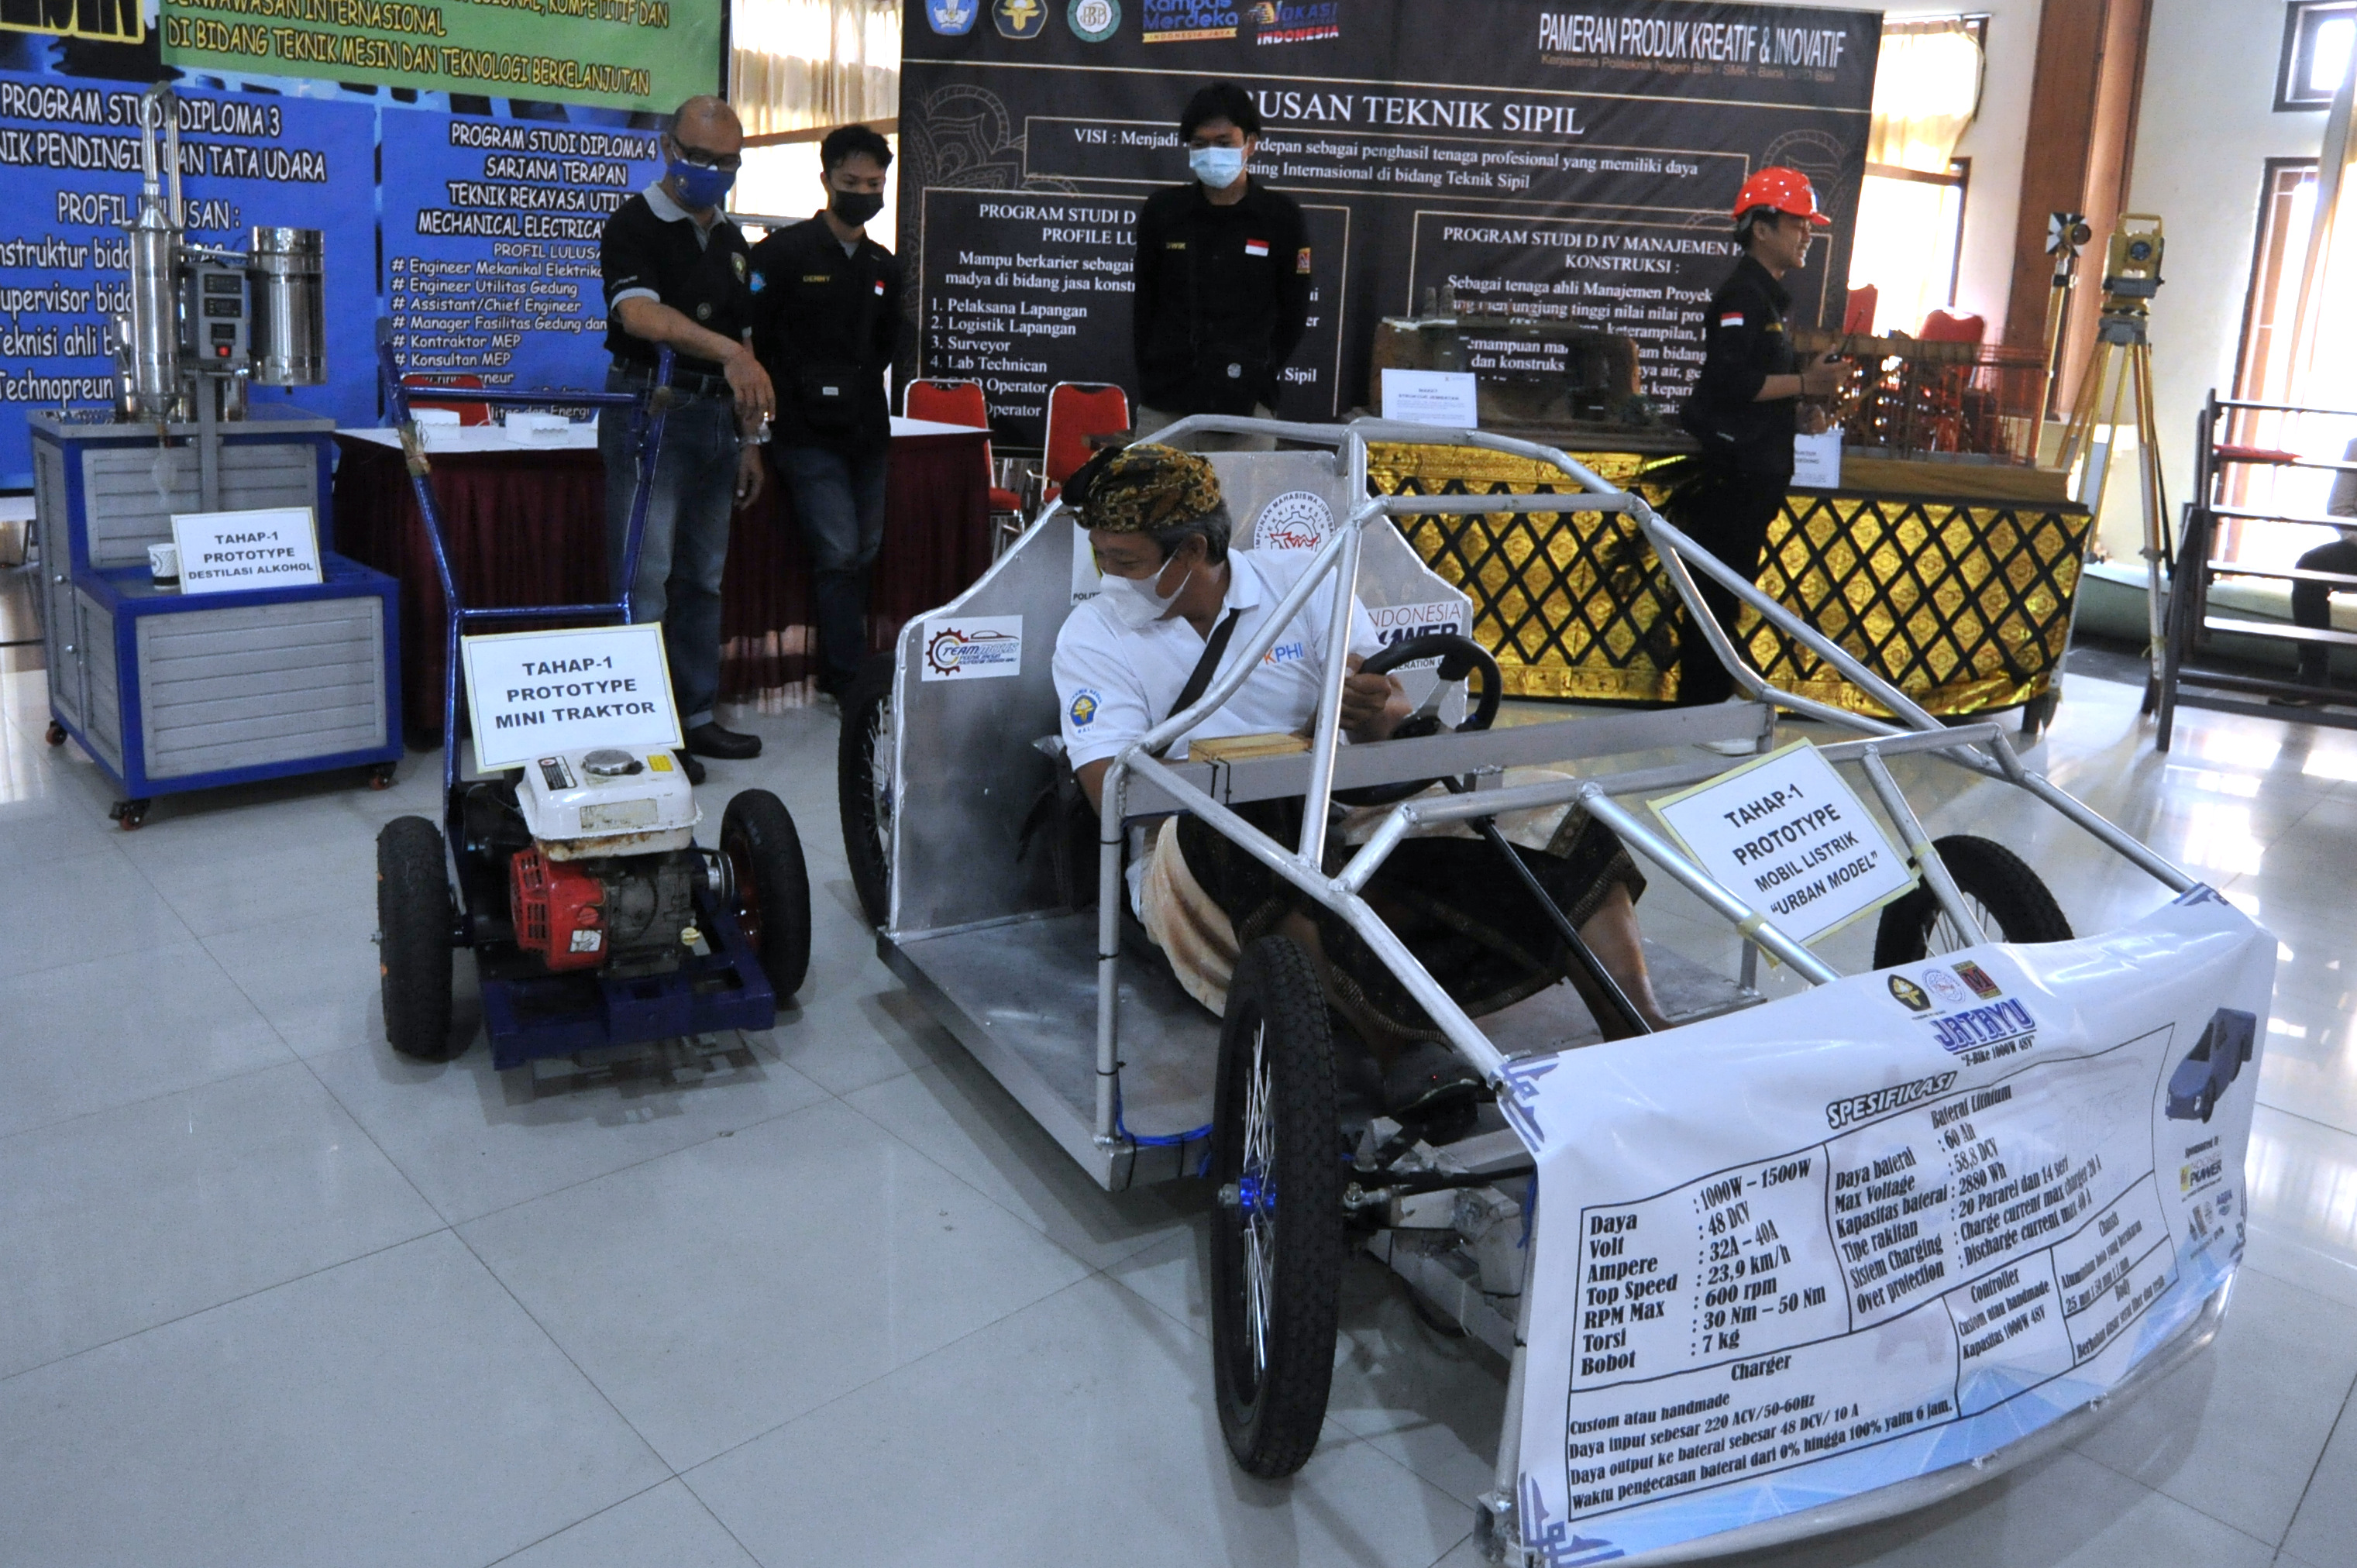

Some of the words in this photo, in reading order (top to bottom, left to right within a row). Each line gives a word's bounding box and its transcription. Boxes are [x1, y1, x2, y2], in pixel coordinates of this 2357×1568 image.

[305, 0, 446, 36] INTERNASIONAL
[638, 2, 668, 27] DAN
[1143, 10, 1237, 30] Merdeka
[1257, 25, 1338, 45] INDONESIA
[1539, 13, 1616, 54] PAMERAN
[1619, 19, 1688, 58] PRODUK
[1691, 22, 1757, 62] KREATIF
[1774, 28, 1846, 67] INOVATIF
[167, 19, 191, 46] DI
[196, 19, 268, 55] BIDANG
[273, 29, 337, 63] TEKNIK
[340, 36, 397, 67] MESIN
[402, 43, 437, 74] DAN
[441, 46, 528, 81] TEKNOLOGI
[532, 58, 649, 95] BERKELANJUTAN
[2, 82, 102, 123] PROGRAM
[179, 100, 263, 135] DIPLOMA
[270, 108, 281, 136] 3
[1247, 91, 1354, 121] USAN
[1363, 95, 1492, 130] TEKNIK
[1502, 103, 1585, 135] SIPIL
[452, 122, 524, 150] PROGRAM
[529, 129, 576, 153] STUDI
[580, 134, 642, 158] DIPLOMA
[1074, 128, 1106, 144] VISI
[1121, 130, 1178, 150] Menjadi
[1306, 140, 1357, 159] sebagai
[1362, 144, 1428, 161] penghasil
[1482, 149, 1558, 169] profesional
[1601, 156, 1661, 174] memiliki
[209, 146, 259, 178] TATA
[264, 150, 325, 181] UDARA
[486, 156, 557, 181] SARJANA
[563, 160, 626, 185] TERAPAN
[1283, 162, 1372, 179] Internasional
[1447, 170, 1493, 187] Teknik
[1497, 173, 1529, 190] Sipil
[57, 191, 131, 225] PROFIL
[449, 182, 507, 206] TEKNIK
[510, 186, 584, 211] REKAYASA
[418, 211, 520, 237] MECHANICAL
[525, 215, 605, 239] ELECTRICA
[979, 204, 1063, 221] PROGRAM
[1068, 208, 1118, 224] STUDI
[1042, 227, 1111, 244] PROFILE
[1443, 226, 1526, 245] PROGRAM
[1531, 231, 1581, 248] STUDI
[1623, 236, 1726, 256] MANAJEMEN
[409, 258, 470, 277] Engineer
[476, 261, 541, 277] Mekanikal
[959, 251, 1012, 268] Mampu
[1016, 253, 1077, 270] berkarier
[1082, 256, 1133, 274] sebagai
[1565, 254, 1671, 273] KONSTRUKSI
[409, 277, 470, 296] Engineer
[475, 279, 525, 294] Utilitas
[529, 280, 576, 297] Gedung
[945, 272, 990, 289] madya
[1013, 273, 1059, 291] bidang
[1553, 280, 1578, 295] ahli
[1583, 282, 1662, 301] Manajemen
[410, 297, 520, 311] Assistant/Chief
[525, 300, 580, 317] Engineer
[948, 298, 1016, 315] Pelaksana
[1020, 301, 1087, 320] Lapangan
[1614, 304, 1645, 320] nilai
[1647, 305, 1677, 322] nilai
[410, 316, 470, 334] Manager
[474, 315, 530, 331] Fasilitas
[535, 317, 581, 334] Gedung
[948, 317, 1004, 334] Logistik
[1009, 319, 1075, 337] Lapangan
[411, 335, 487, 349] Kontraktor
[492, 335, 521, 349] MEP
[948, 336, 1010, 352] Surveyor
[411, 353, 477, 367] Konsultan
[481, 353, 511, 366] MEP
[986, 377, 1047, 394] Operator
[1272, 493, 1317, 509] MAHASISWA
[214, 531, 278, 545] TAHAP-1
[204, 547, 295, 563] PROTOTYPE
[188, 566, 252, 580] DESTILASI
[256, 562, 313, 575] ALKOHOL
[521, 656, 613, 676] TAHAP-1
[1263, 641, 1303, 665] KPHI
[506, 678, 637, 702] PROTOTYPE
[495, 710, 545, 728] MINI
[552, 701, 655, 721] TRAKTOR
[1723, 782, 1804, 828] TAHAP-1
[1732, 803, 1841, 865] PROTOTYPE
[1754, 861, 1803, 892] MOBIL
[1801, 830, 1859, 868] LISTRIK
[1929, 997, 2036, 1052] JATAYU
[1825, 1070, 1957, 1130] SPESIFIKASI
[1699, 1176, 1743, 1211] 1000W
[1760, 1157, 1812, 1189] 1500W
[1834, 1167, 1870, 1191] Daya
[1865, 1174, 1915, 1205] Voltage
[1835, 1205, 1899, 1240] Kapasitas
[1957, 1171, 1987, 1196] 2880
[1870, 1219, 1918, 1250] rakitan
[1977, 1177, 2020, 1212] Pararel
[1589, 1213, 1638, 1235] Daya
[1589, 1237, 1624, 1259] Volt
[1708, 1236, 1740, 1261] 32A
[1849, 1259, 1888, 1290] Sistem
[1887, 1232, 1944, 1267] Charging
[1960, 1209, 2001, 1240] Charge
[1587, 1257, 1658, 1284] Ampere
[1750, 1243, 1791, 1274] km/h
[1889, 1259, 1945, 1297] protection
[1963, 1229, 2018, 1266] Discharge
[1585, 1287, 1619, 1307] Top
[1625, 1274, 1677, 1298] Speed
[1705, 1284, 1738, 1308] 600
[1743, 1276, 1777, 1300] rpm
[2005, 1280, 2050, 1315] handmade
[1583, 1306, 1624, 1329] RPM
[1629, 1300, 1665, 1322] Max
[1582, 1329, 1626, 1353] Torsi
[1962, 1326, 2004, 1360] Kapasitas
[1580, 1350, 1636, 1377] Bobot
[1730, 1353, 1791, 1382] Charger
[1569, 1440, 1604, 1460] Daya
[1650, 1422, 1701, 1446] sebesar
[1732, 1394, 1815, 1426] ACV/50-60Hz
[1570, 1414, 1619, 1435] Custom
[1624, 1409, 1657, 1426] atau
[1660, 1393, 1729, 1421] handmade
[1570, 1465, 1605, 1485] Daya
[1609, 1454, 1653, 1477] output
[1729, 1425, 1777, 1449] sebesar
[1572, 1487, 1614, 1510] Waktu
[1618, 1467, 1695, 1501] pengecasan
[1804, 1428, 1846, 1453] hingga
